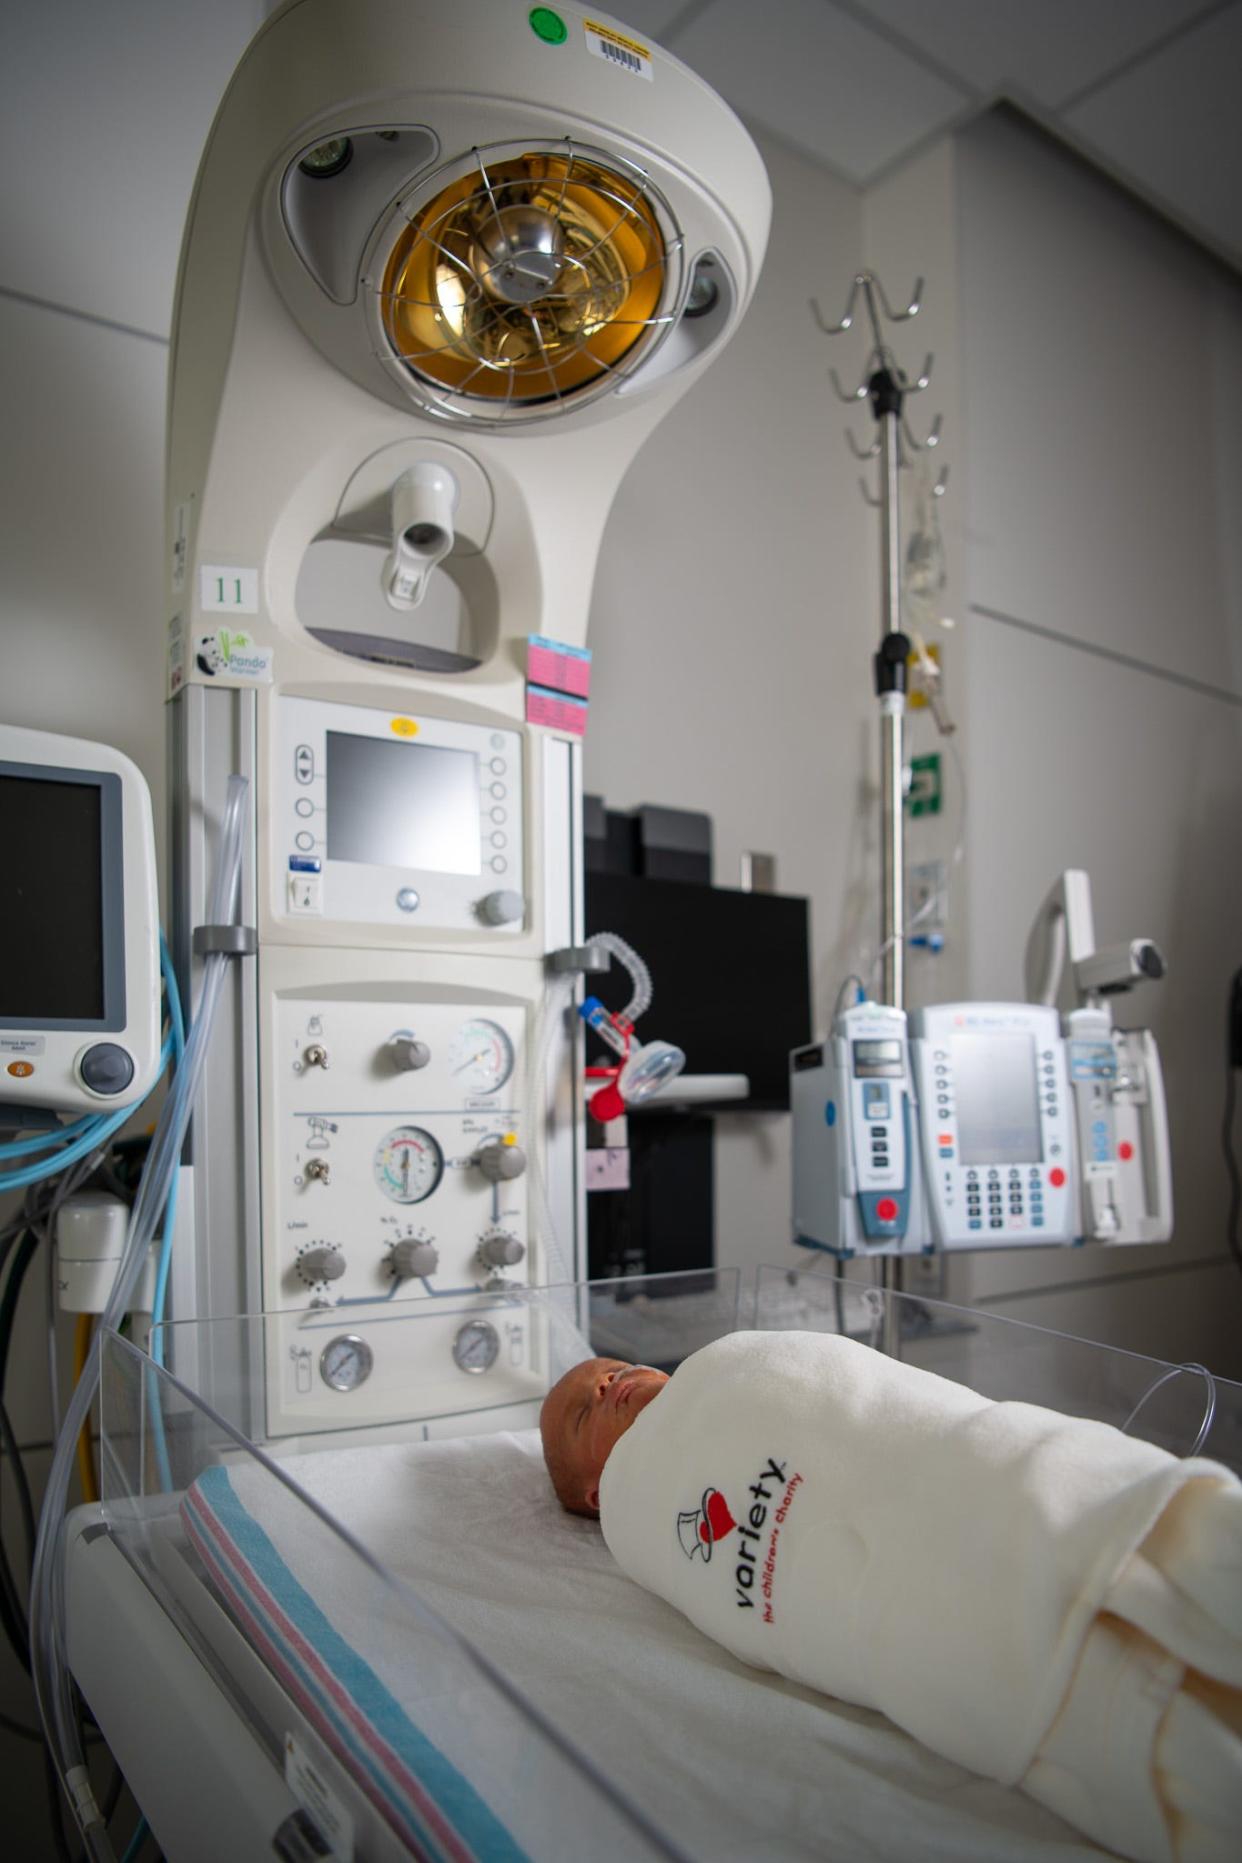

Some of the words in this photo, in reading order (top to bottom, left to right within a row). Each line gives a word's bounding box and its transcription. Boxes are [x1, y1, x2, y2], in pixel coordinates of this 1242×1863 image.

[217, 577, 241, 603] 11
[775, 1472, 803, 1524] charity
[736, 1458, 786, 1608] variety
